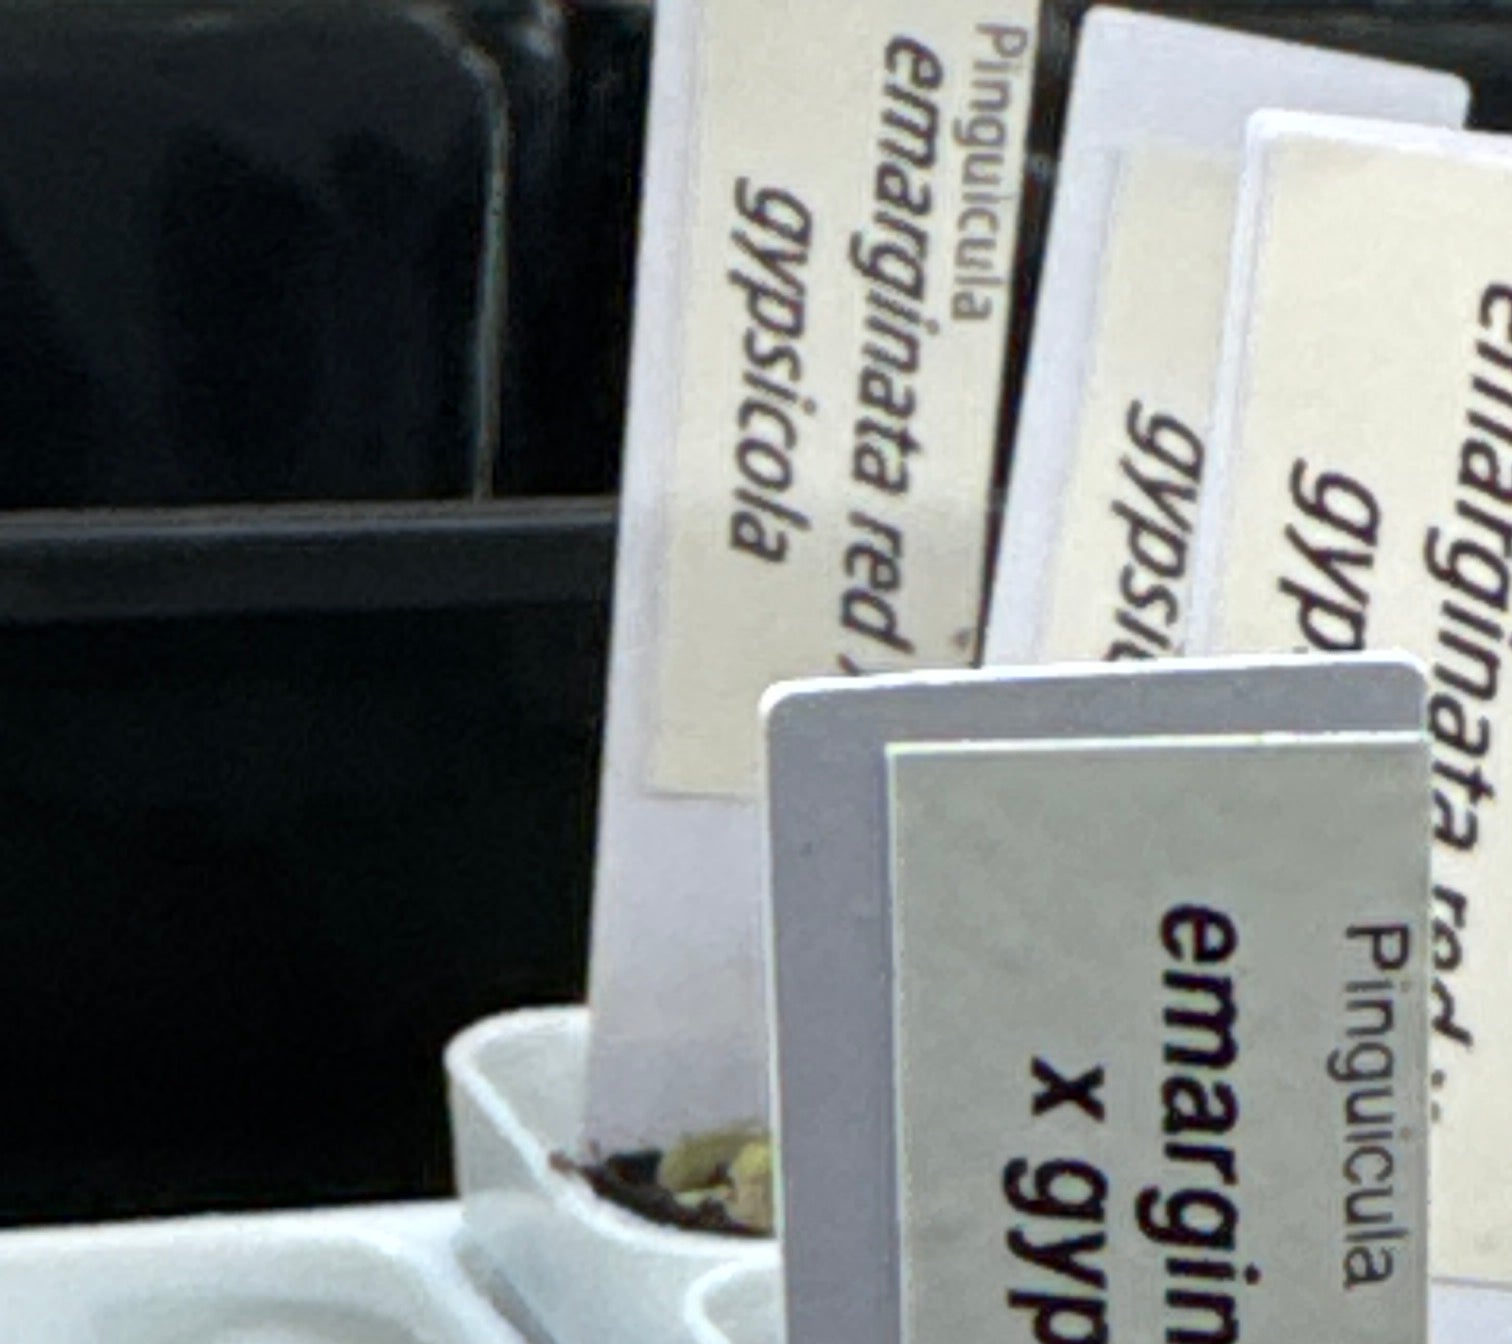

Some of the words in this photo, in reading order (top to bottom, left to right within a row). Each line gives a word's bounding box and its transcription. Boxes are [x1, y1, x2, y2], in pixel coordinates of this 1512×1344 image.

[847, 36, 944, 496] emarginata
[951, 24, 1029, 323] Pinguicula
[727, 177, 816, 563] gypsicola
[839, 511, 915, 654] red
[1031, 1058, 1105, 1121] x
[1326, 924, 1411, 1289] Pinguicula
